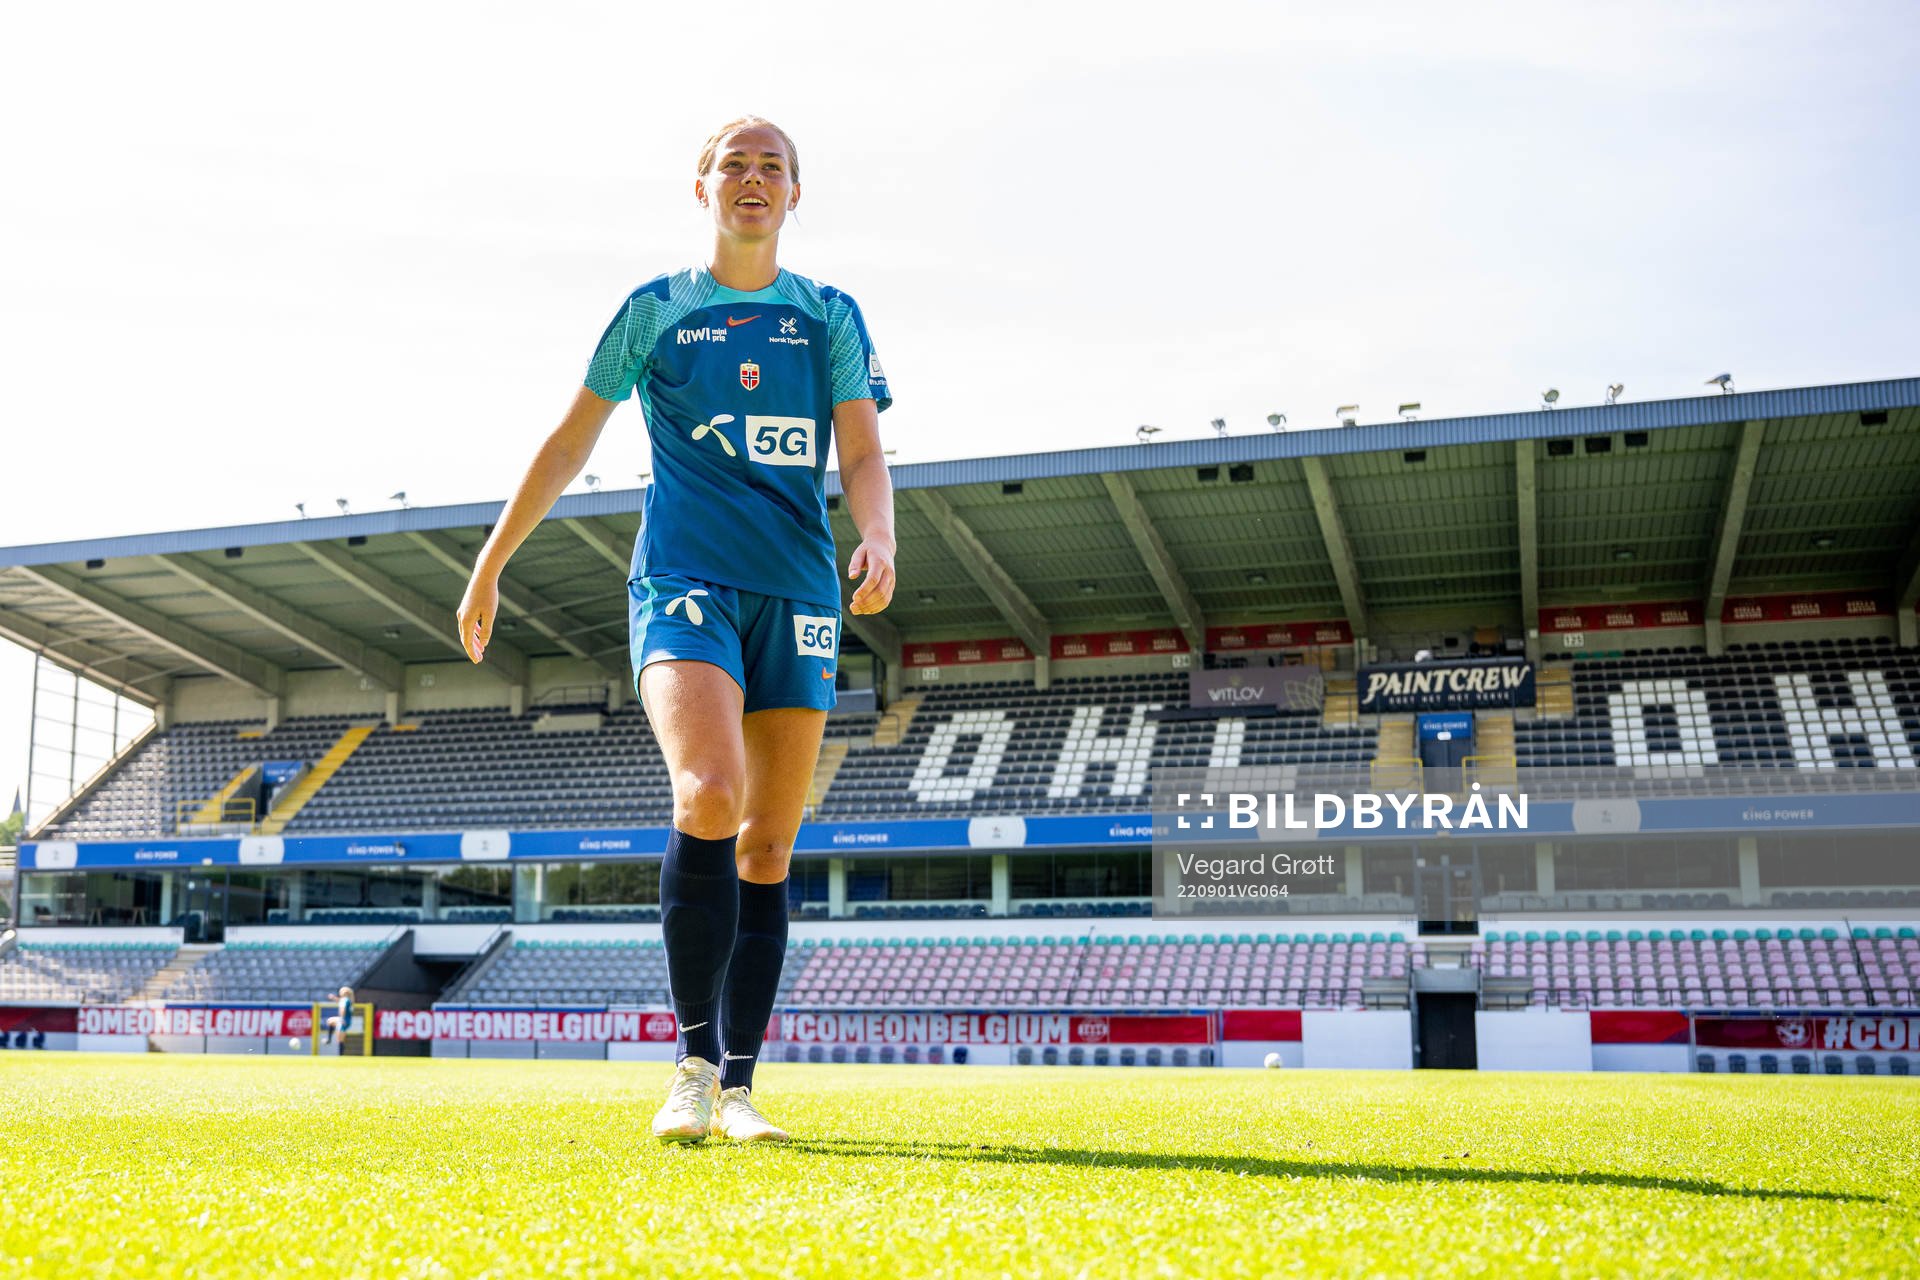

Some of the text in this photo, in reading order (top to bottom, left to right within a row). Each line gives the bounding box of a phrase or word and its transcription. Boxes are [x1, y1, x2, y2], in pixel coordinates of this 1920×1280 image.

[676, 327, 728, 345] KIWI mini
[712, 335, 726, 343] pris
[753, 426, 808, 457] 5G
[802, 623, 833, 650] 5G
[1208, 686, 1264, 702] WITLOV
[1361, 664, 1531, 705] PAINTCREW
[379, 1011, 640, 1041] #COMEONBELGIUM
